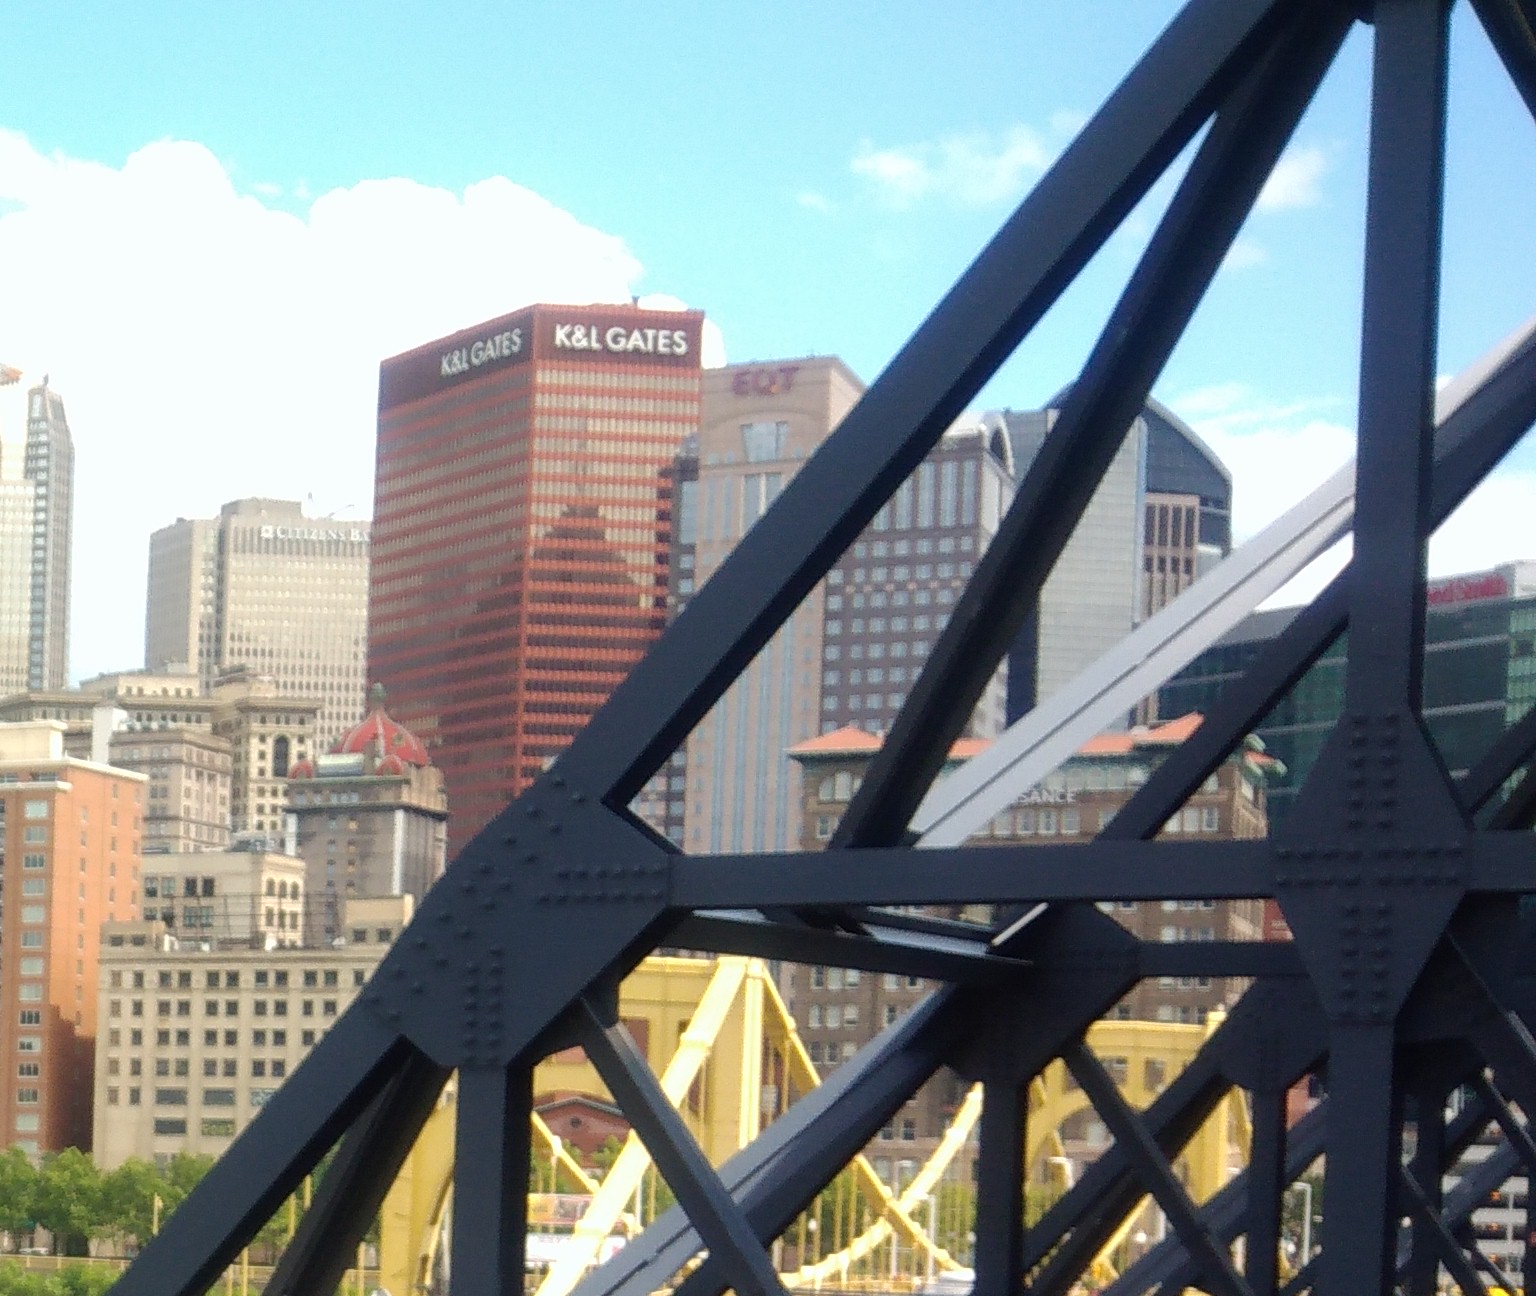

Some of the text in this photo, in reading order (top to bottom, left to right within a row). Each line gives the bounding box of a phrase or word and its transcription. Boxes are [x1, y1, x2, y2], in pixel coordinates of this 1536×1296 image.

[440, 327, 522, 376] K&L GATES
[555, 323, 688, 356] K&L GATES
[732, 364, 800, 396] EQT
